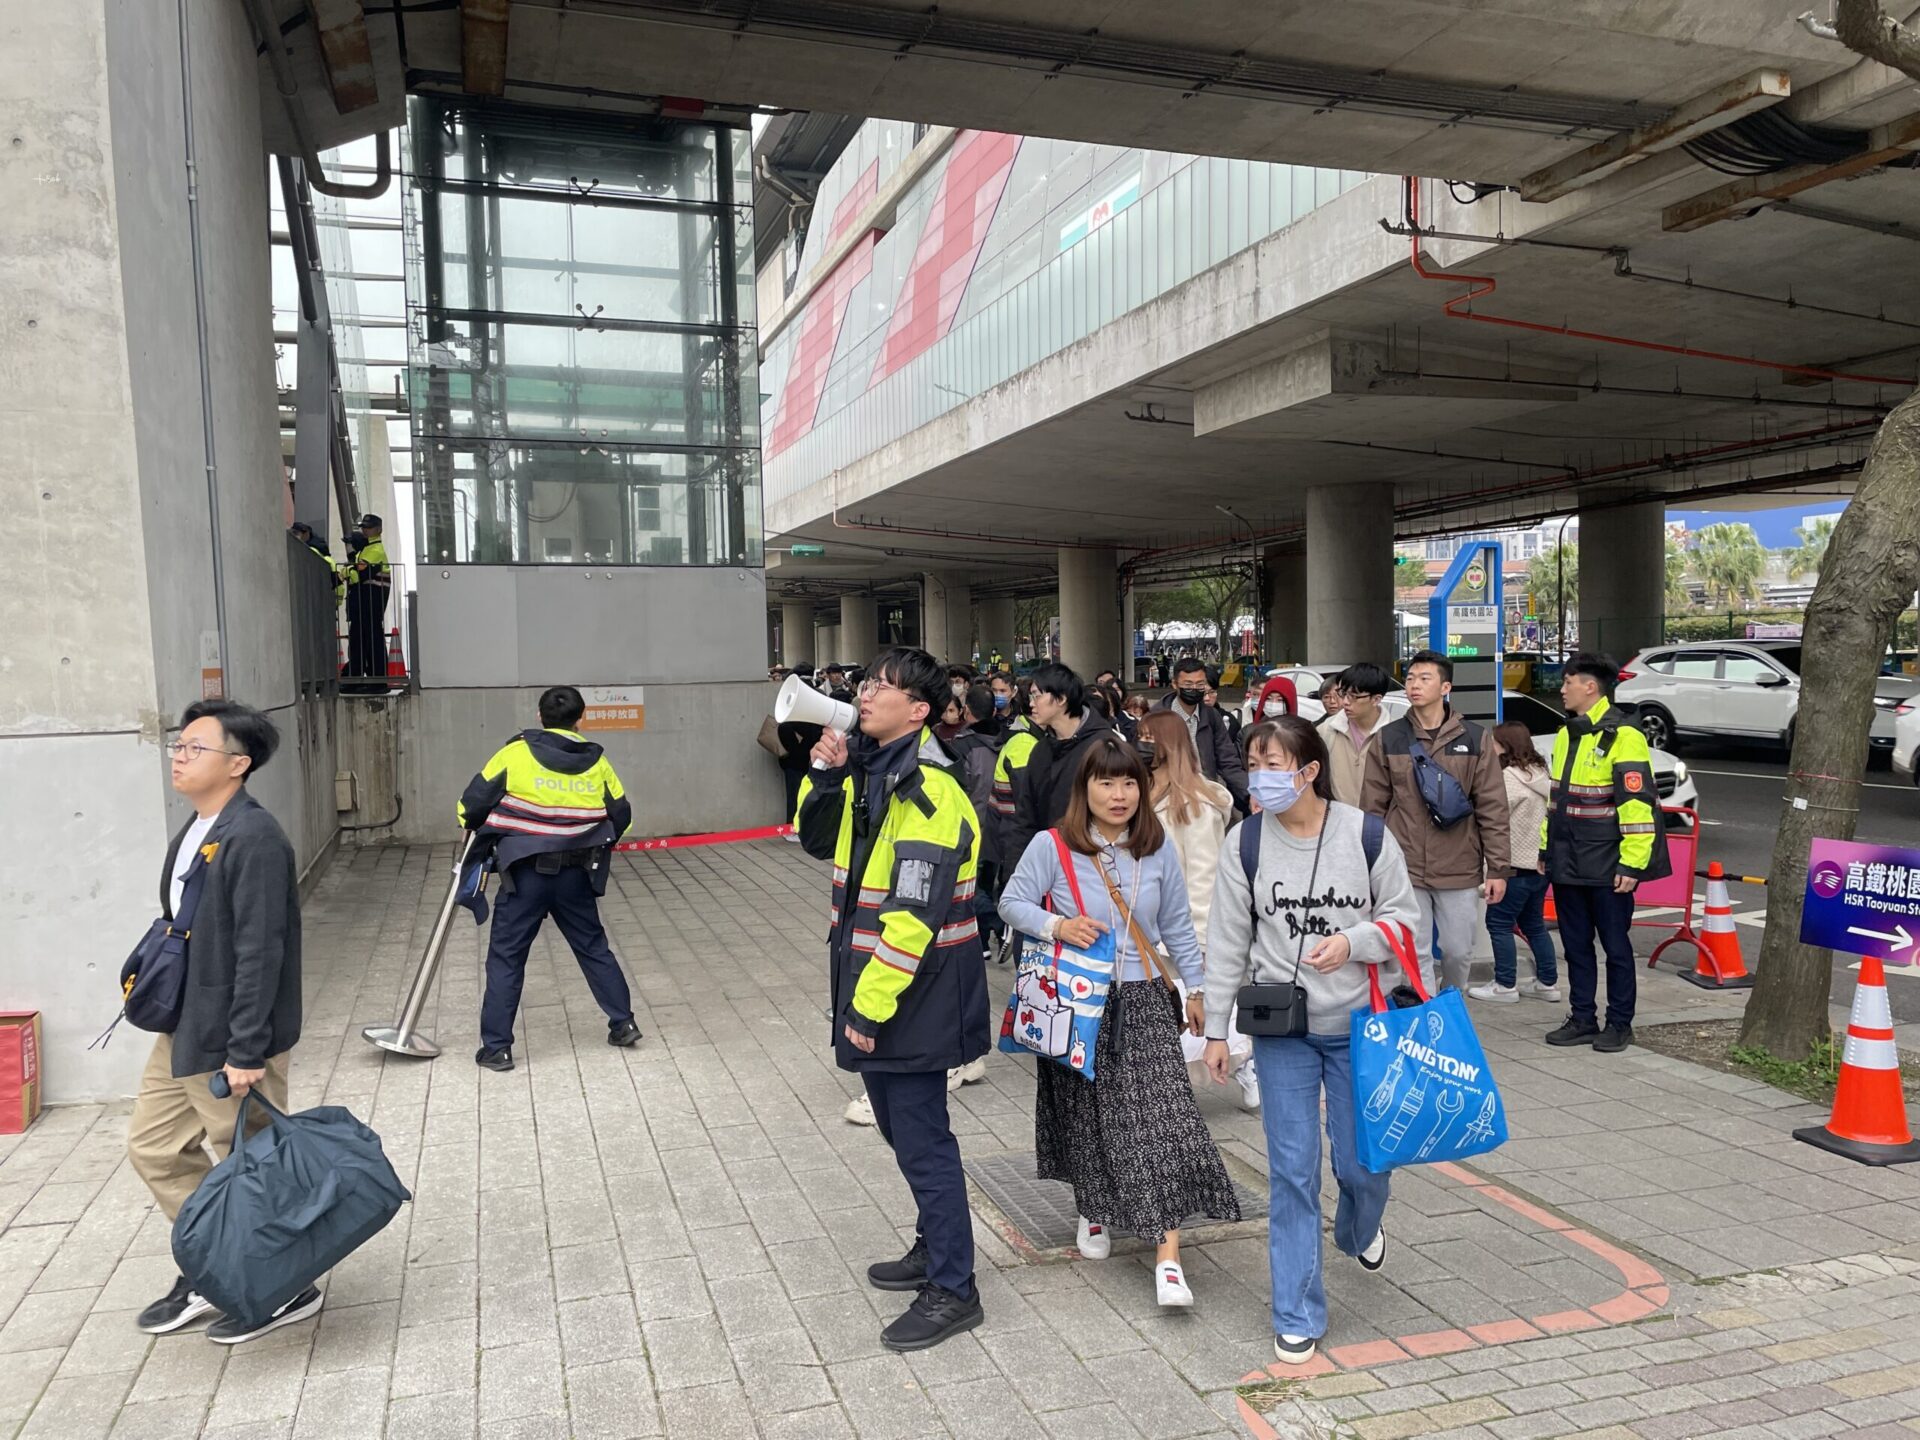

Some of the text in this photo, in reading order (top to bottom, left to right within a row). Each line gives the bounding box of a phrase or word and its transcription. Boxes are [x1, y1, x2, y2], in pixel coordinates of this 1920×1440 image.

[1453, 607, 1494, 617] 高鐵桃園站
[1458, 645, 1478, 655] mins
[534, 777, 597, 793] POLICE
[1265, 881, 1366, 916] Somewhere
[1844, 893, 1920, 916] HSR Taoyuan St
[1420, 1066, 1443, 1081] Enjoy
[1444, 1077, 1462, 1087] your
